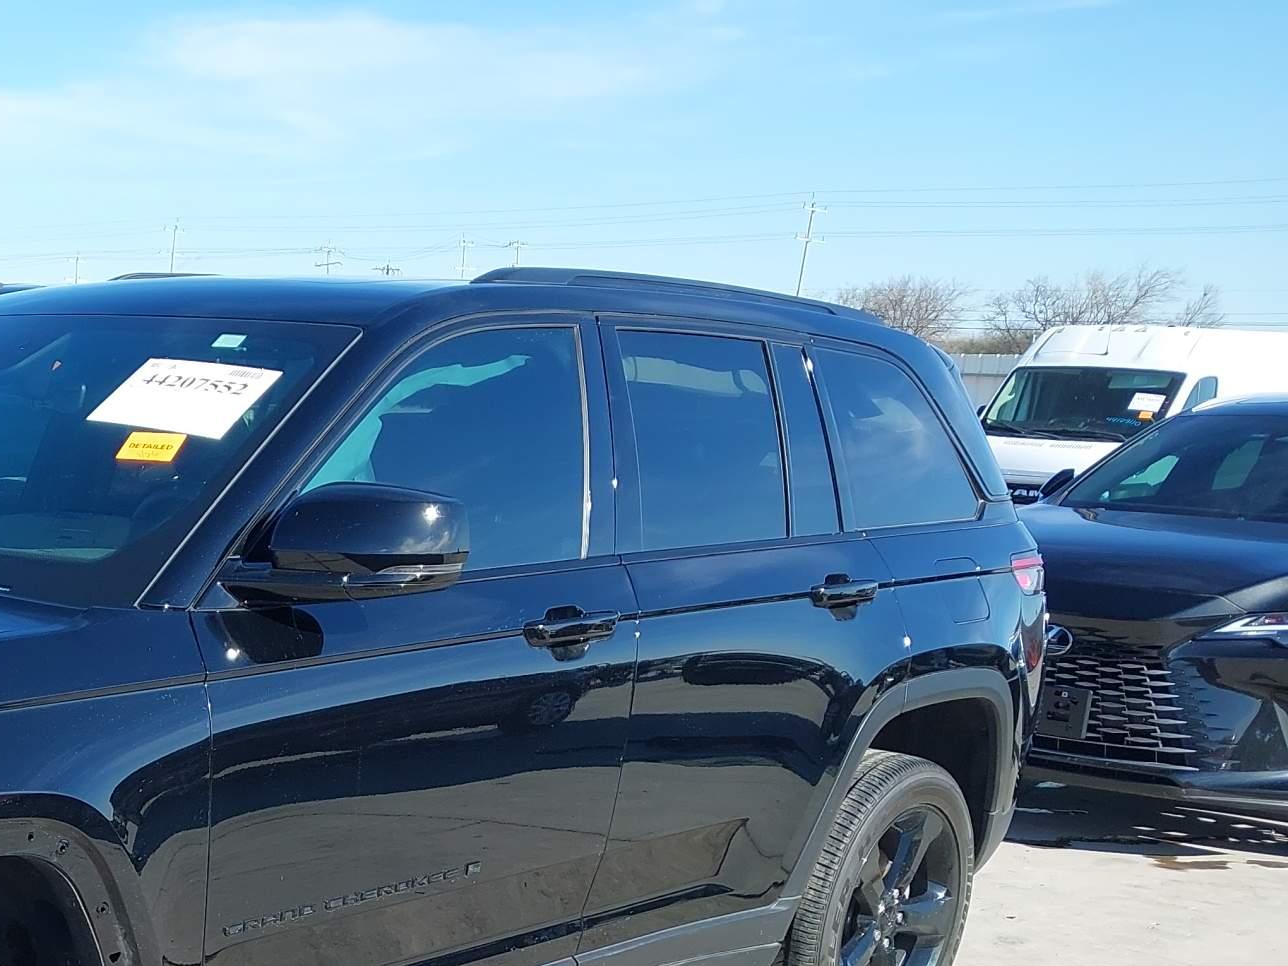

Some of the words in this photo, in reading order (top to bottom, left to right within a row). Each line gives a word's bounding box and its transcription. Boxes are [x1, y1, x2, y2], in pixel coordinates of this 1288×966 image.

[143, 372, 250, 396] 44207552
[128, 442, 174, 451] DETAILED
[222, 903, 316, 937] GRAND
[323, 867, 462, 912] CHEROKEE
